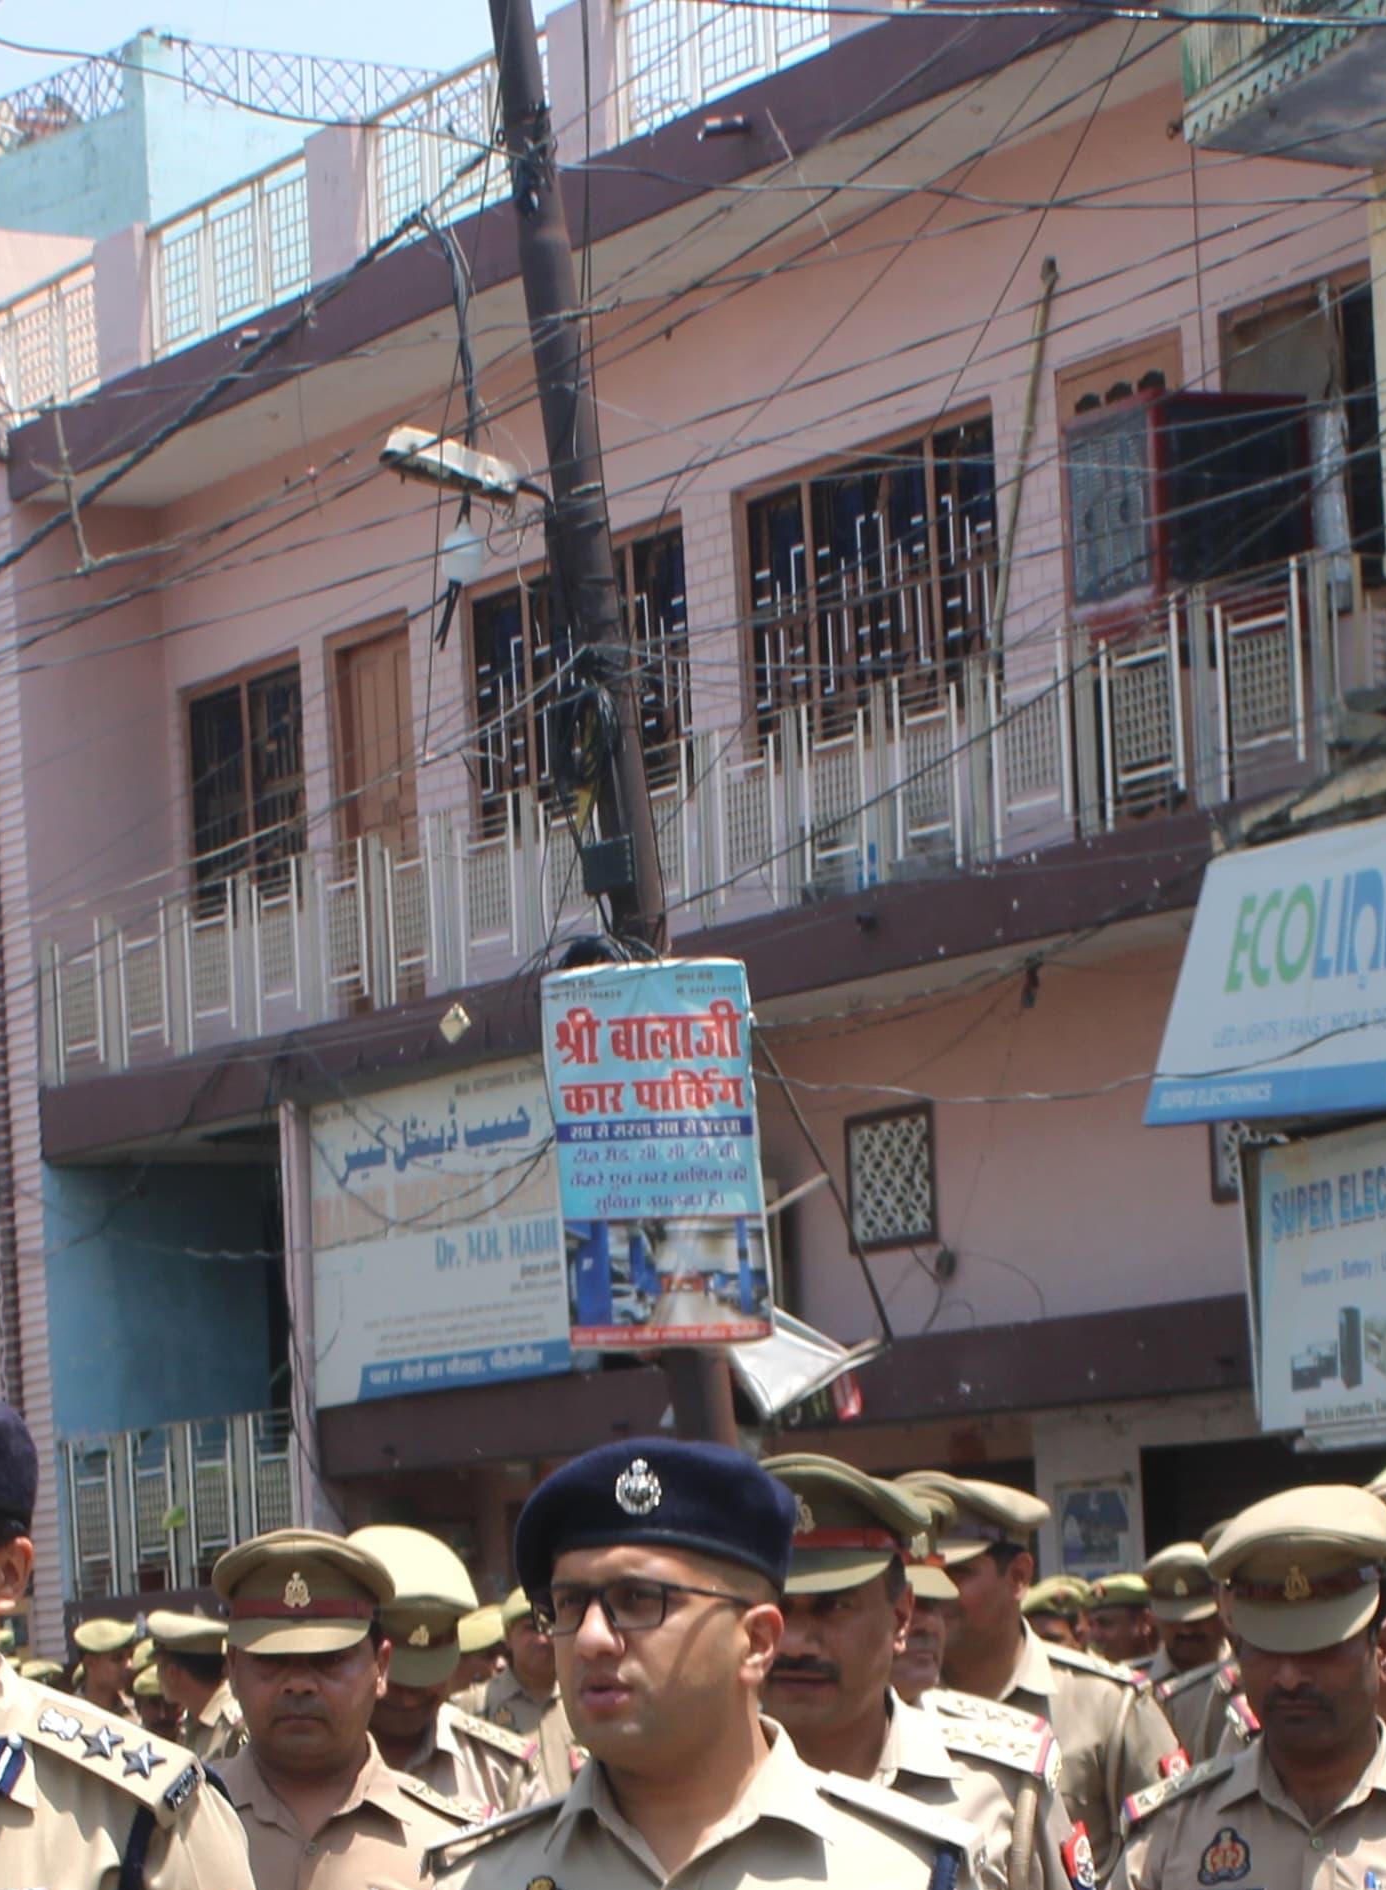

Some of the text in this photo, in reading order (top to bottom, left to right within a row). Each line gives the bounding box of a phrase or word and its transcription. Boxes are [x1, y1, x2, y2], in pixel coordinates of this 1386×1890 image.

[555, 999, 742, 1065] श्री बालाजी
[559, 1082, 624, 1115] कार
[1271, 1180, 1334, 1242] SUPER
[436, 1237, 461, 1271] Dr.
